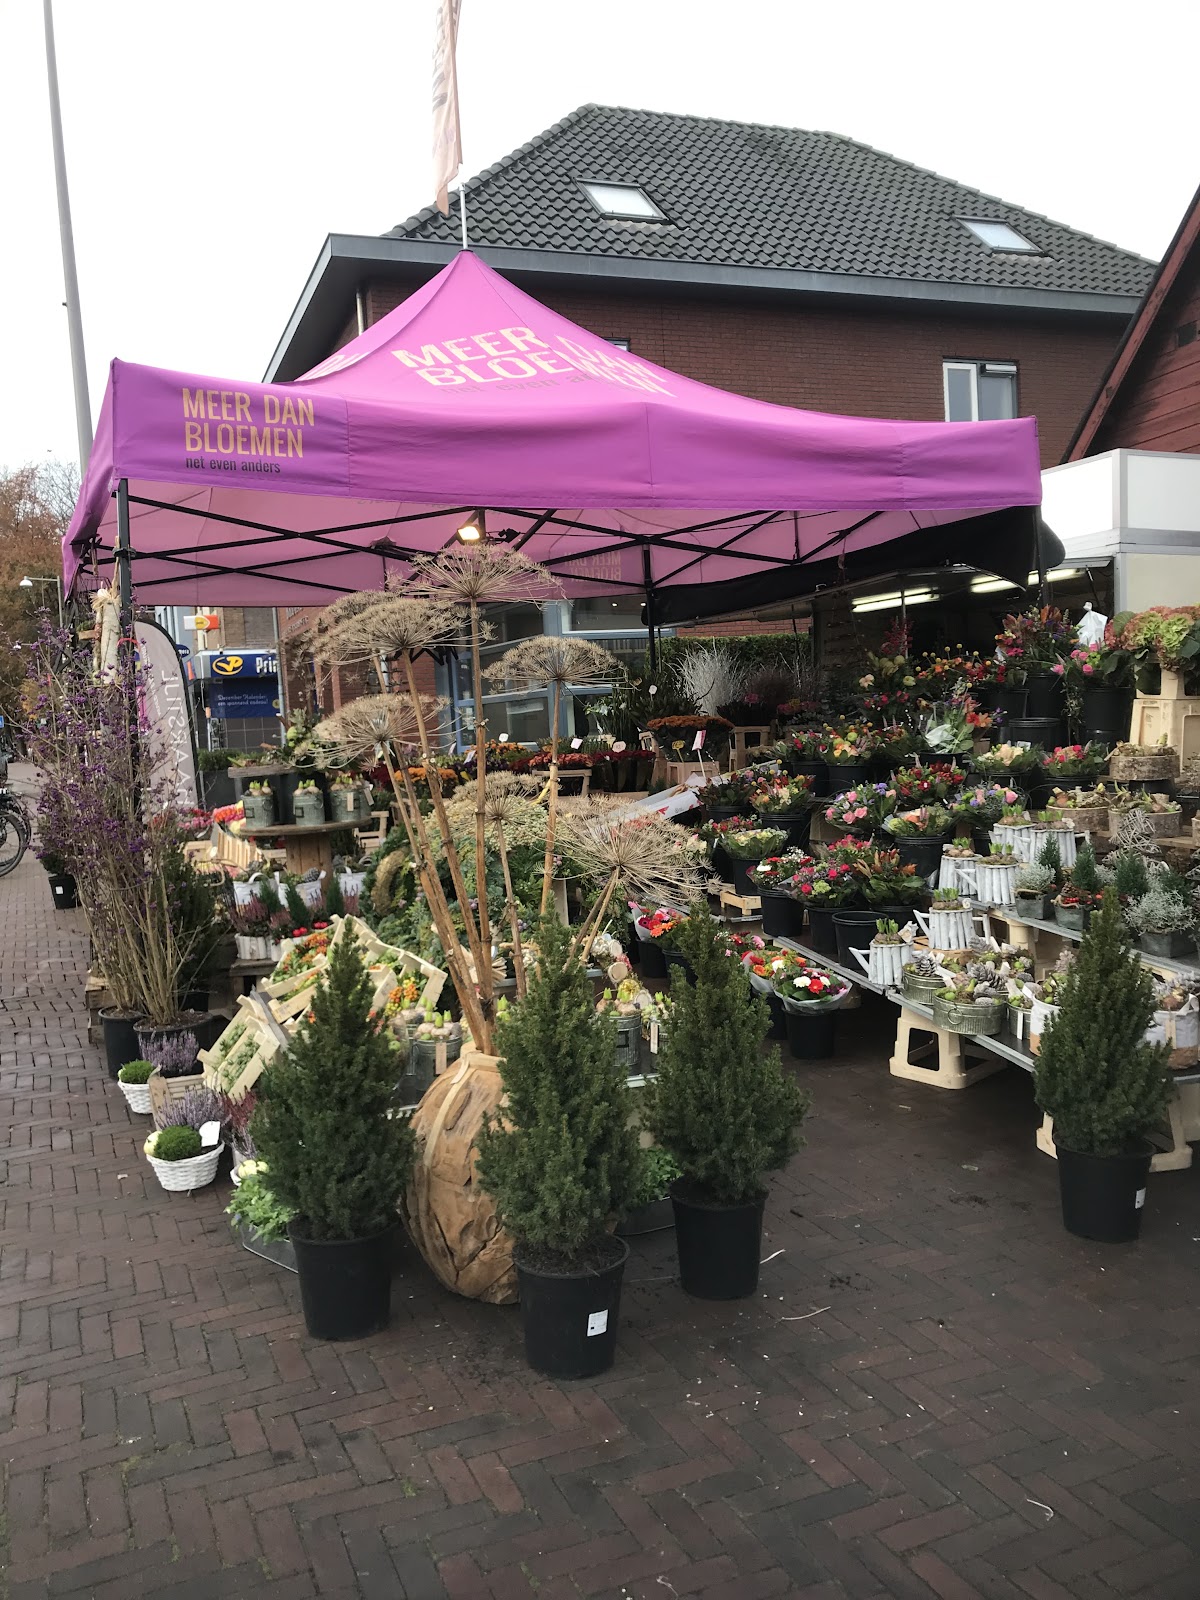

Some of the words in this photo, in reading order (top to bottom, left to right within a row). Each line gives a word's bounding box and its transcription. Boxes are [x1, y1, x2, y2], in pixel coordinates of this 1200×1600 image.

[391, 326, 550, 368] MEER
[495, 377, 560, 392] even
[182, 387, 253, 422] MEER
[263, 394, 315, 427] DAN
[185, 421, 304, 458] BLOEMEN
[186, 456, 205, 469] net
[209, 458, 237, 471] even
[241, 459, 281, 473] anders
